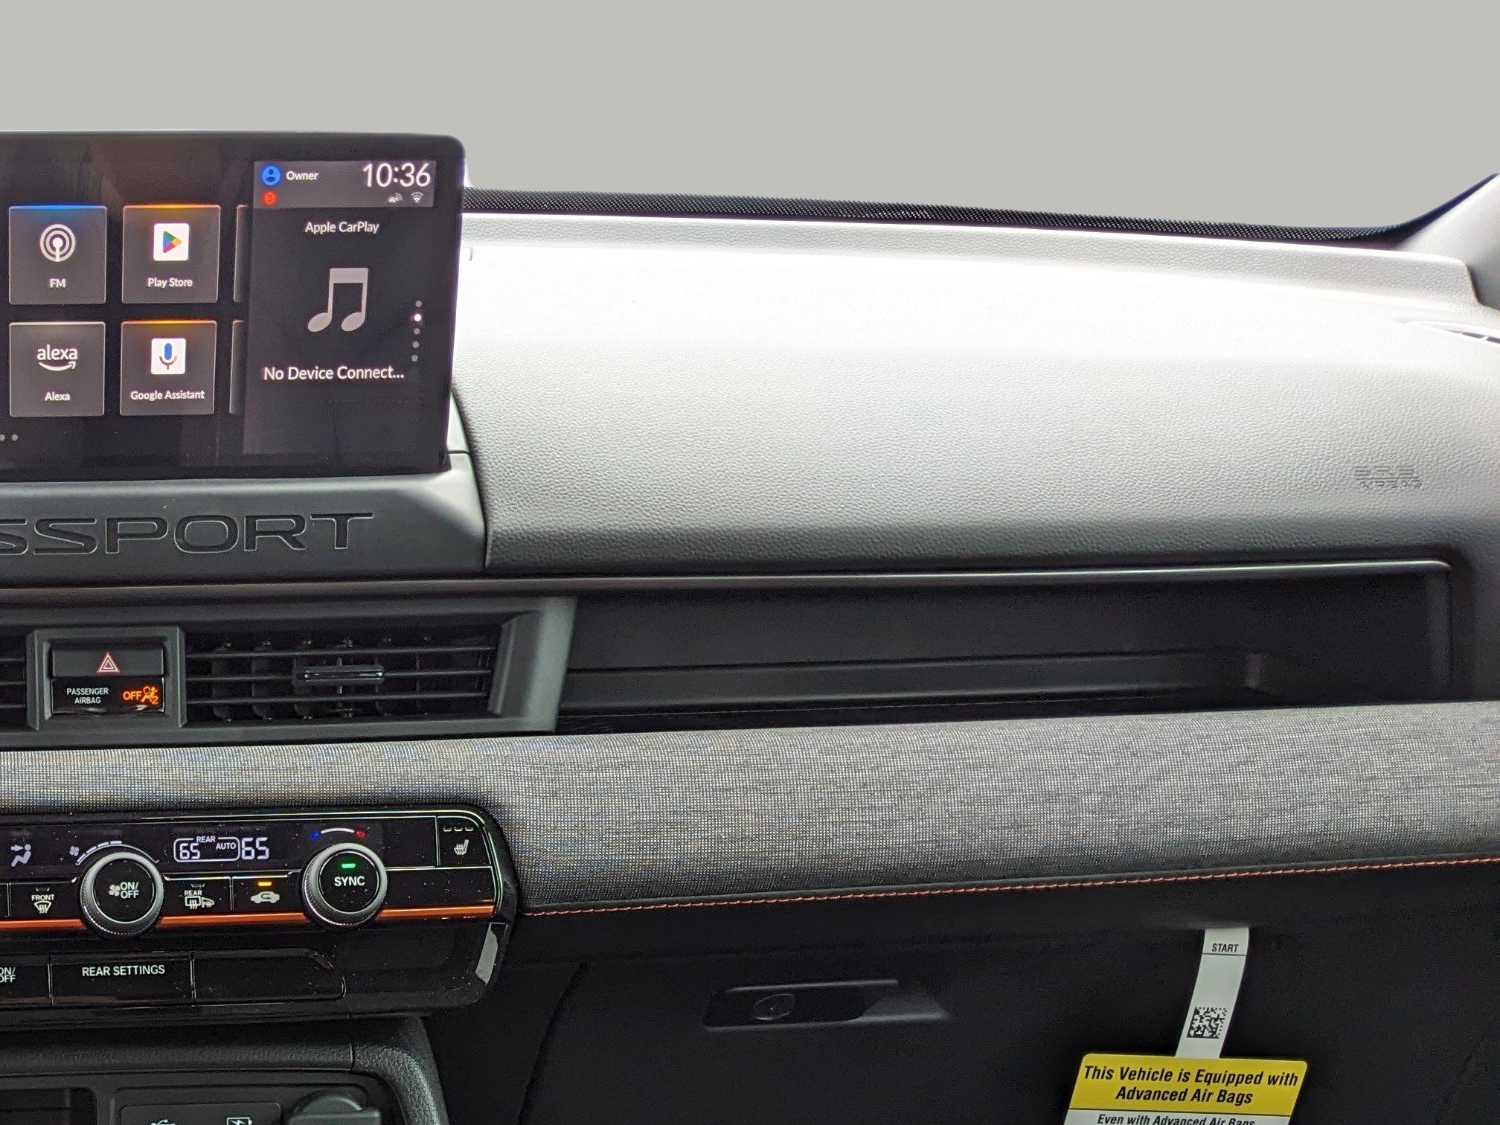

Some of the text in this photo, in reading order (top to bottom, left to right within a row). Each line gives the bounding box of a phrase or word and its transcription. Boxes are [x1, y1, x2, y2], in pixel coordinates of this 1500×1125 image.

[286, 171, 319, 181] Owner
[363, 162, 431, 187] 10:36
[305, 221, 379, 234] Apple CarPlay
[50, 278, 66, 288] FM
[147, 277, 193, 288] Play Store
[37, 344, 78, 360] alexa
[263, 365, 404, 380] No Device Connect...
[45, 391, 70, 401] Alexa
[130, 390, 205, 401] Google Assistant
[66, 687, 109, 696] PASSENGER
[123, 690, 142, 701] OFF
[74, 696, 102, 704] AIRBAG
[179, 842, 236, 859] 65 AUTO
[241, 837, 269, 860] 65
[334, 875, 365, 887] SYNC
[120, 882, 139, 892] ON/
[121, 890, 139, 899] OFF
[1212, 943, 1239, 953] START
[82, 965, 165, 976] REAR SETTINGS
[1083, 1065, 1298, 1086] This Vehicle is Equipped with
[1115, 1086, 1253, 1106] Advanced Air Bags
[1097, 1114, 1124, 1125] Even
[1127, 1115, 1150, 1125] with
